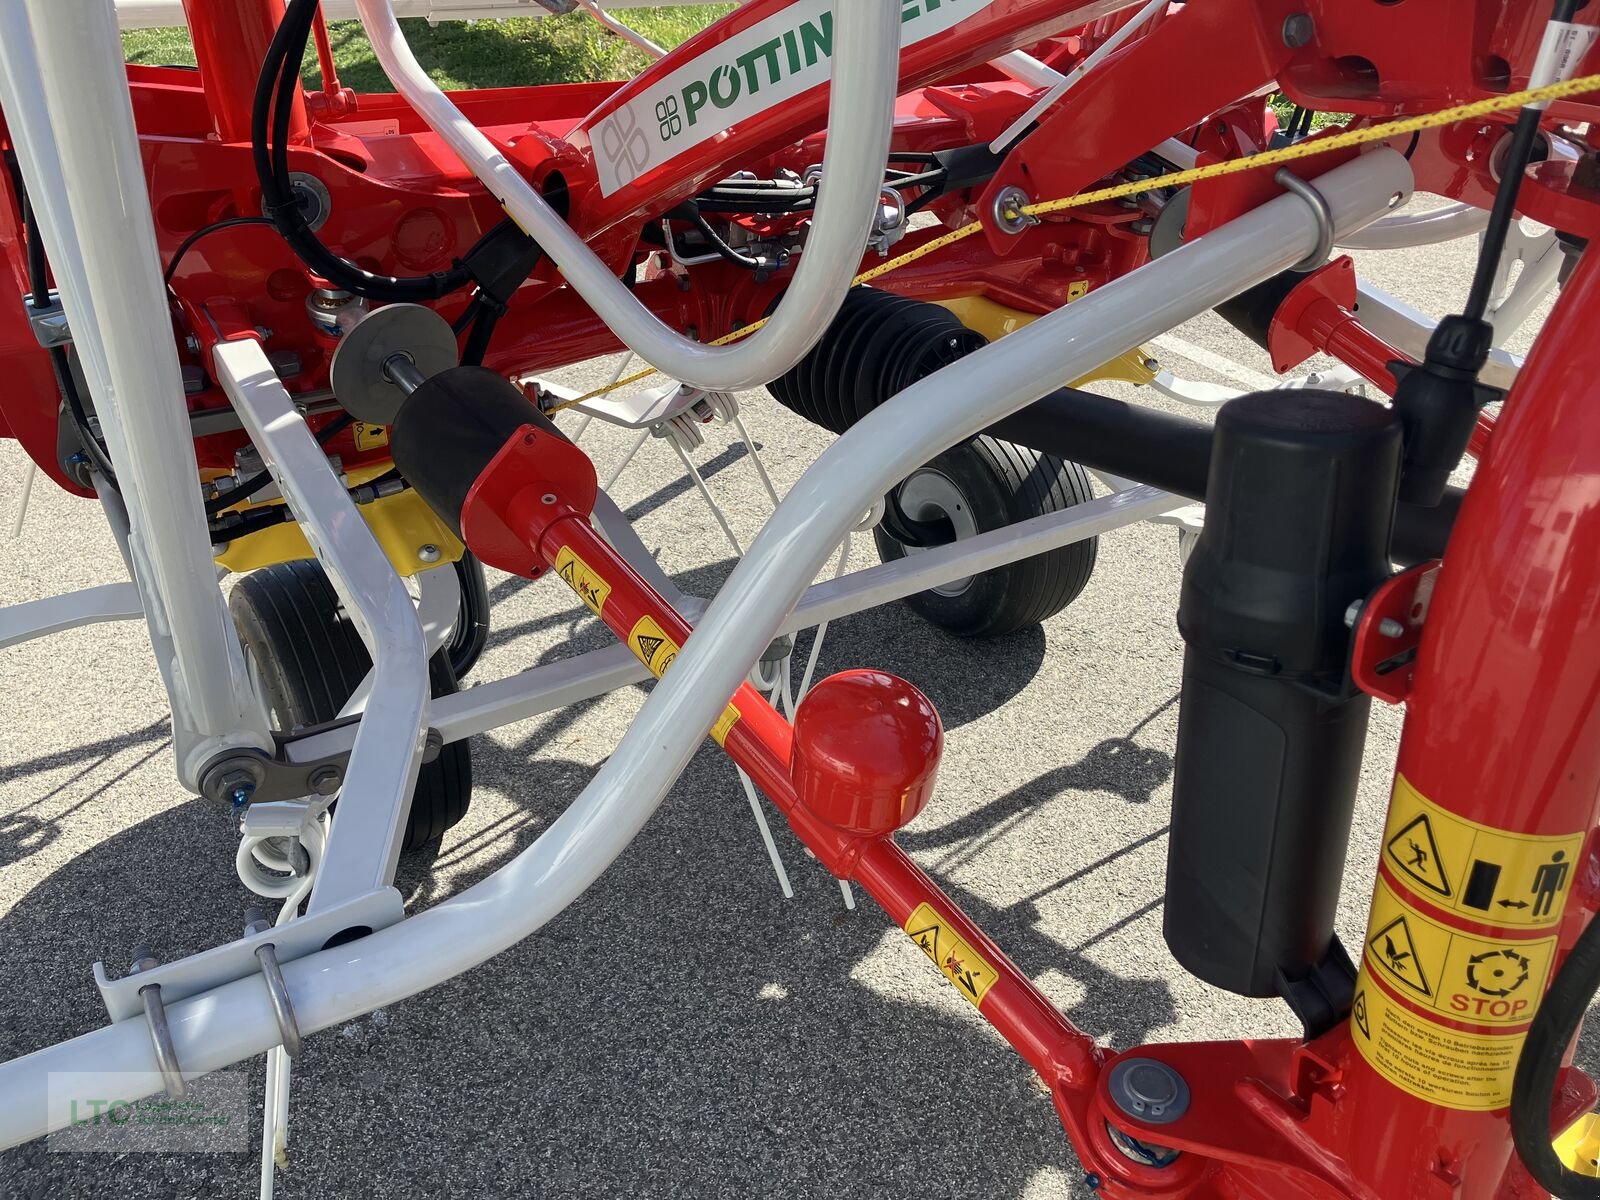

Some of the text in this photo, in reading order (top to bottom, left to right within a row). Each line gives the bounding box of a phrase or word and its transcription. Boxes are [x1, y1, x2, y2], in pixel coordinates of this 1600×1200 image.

[1450, 994, 1528, 1017] STOP
[1385, 1012, 1408, 1031] Muttern
[1428, 1038, 1469, 1054] Schrauben
[1386, 1007, 1400, 1021] Nach
[1402, 1020, 1415, 1029] den
[1417, 1028, 1440, 1040] ersten
[1380, 1036, 1402, 1056] Tighten
[1403, 1054, 1419, 1066] nuts
[1421, 1063, 1436, 1072] and
[1438, 1069, 1464, 1080] screws
[1392, 1052, 1399, 1061] 10
[1401, 1058, 1420, 1072] hours
[1414, 1048, 1440, 1063] heures
[1418, 1077, 1426, 1085] 10
